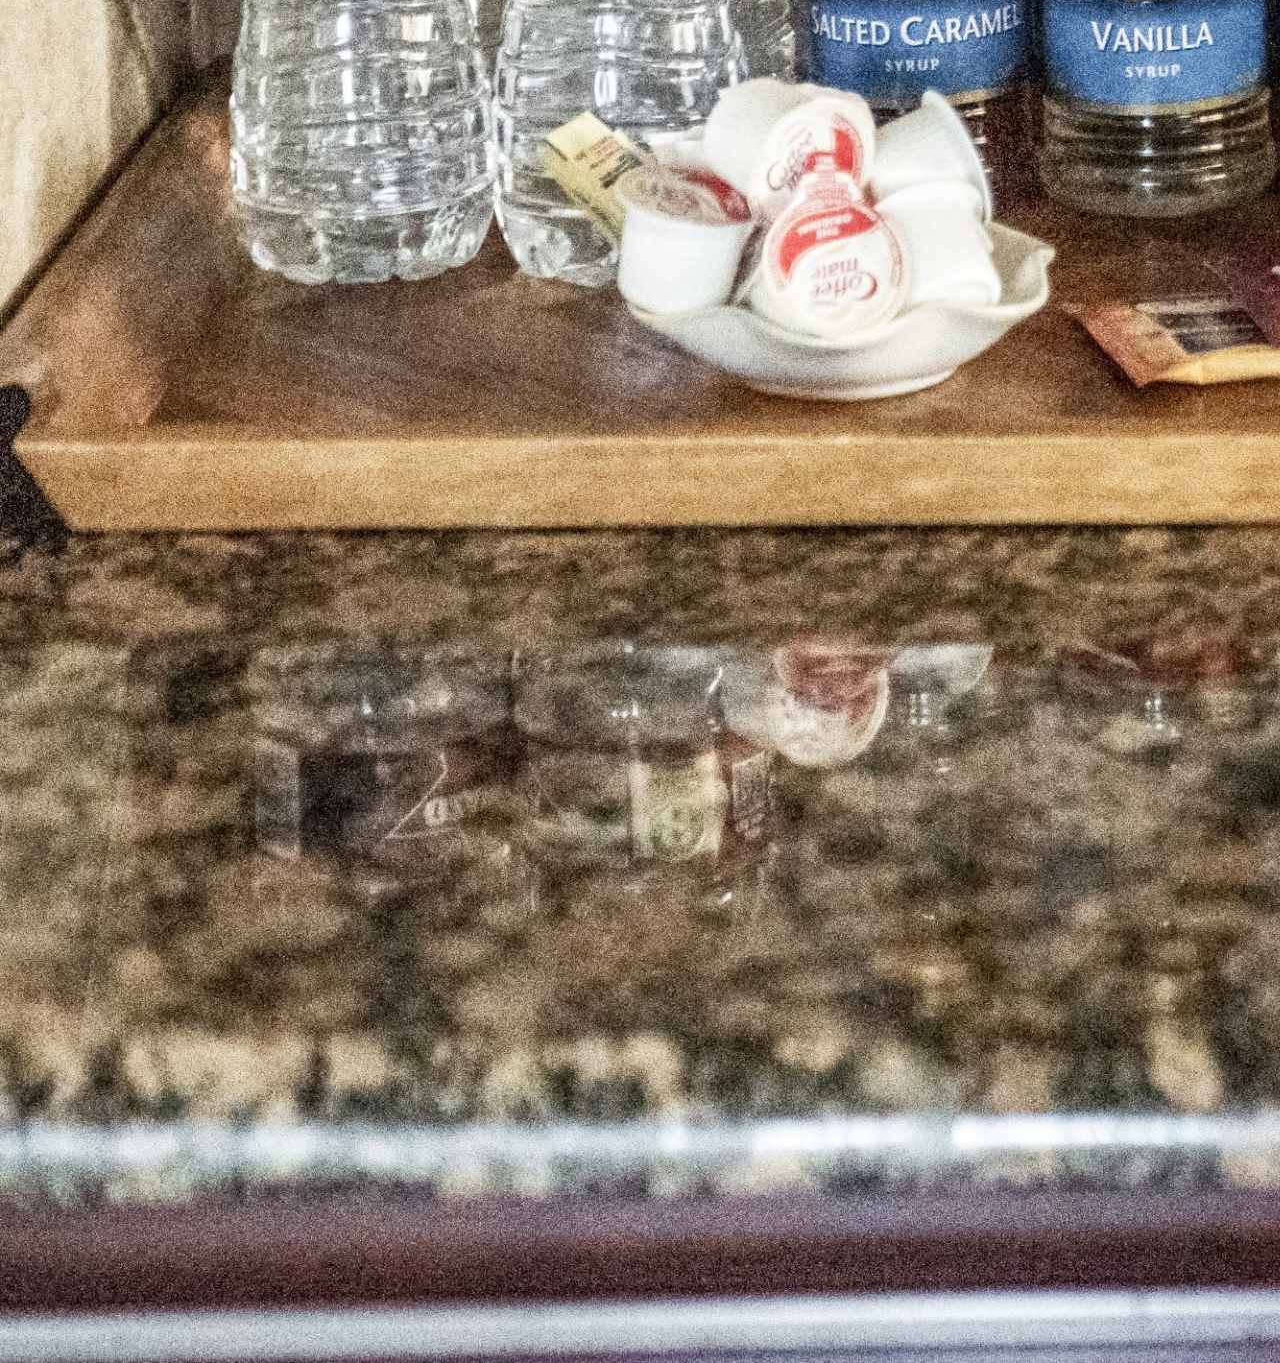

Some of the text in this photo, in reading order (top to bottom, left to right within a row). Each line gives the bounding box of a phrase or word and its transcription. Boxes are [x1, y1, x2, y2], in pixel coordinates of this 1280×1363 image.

[811, 3, 1023, 48] SALTED CARAMEL
[1091, 20, 1214, 53] VANILLA
[884, 57, 940, 72] SYRUP
[1124, 63, 1181, 78] SYRUP
